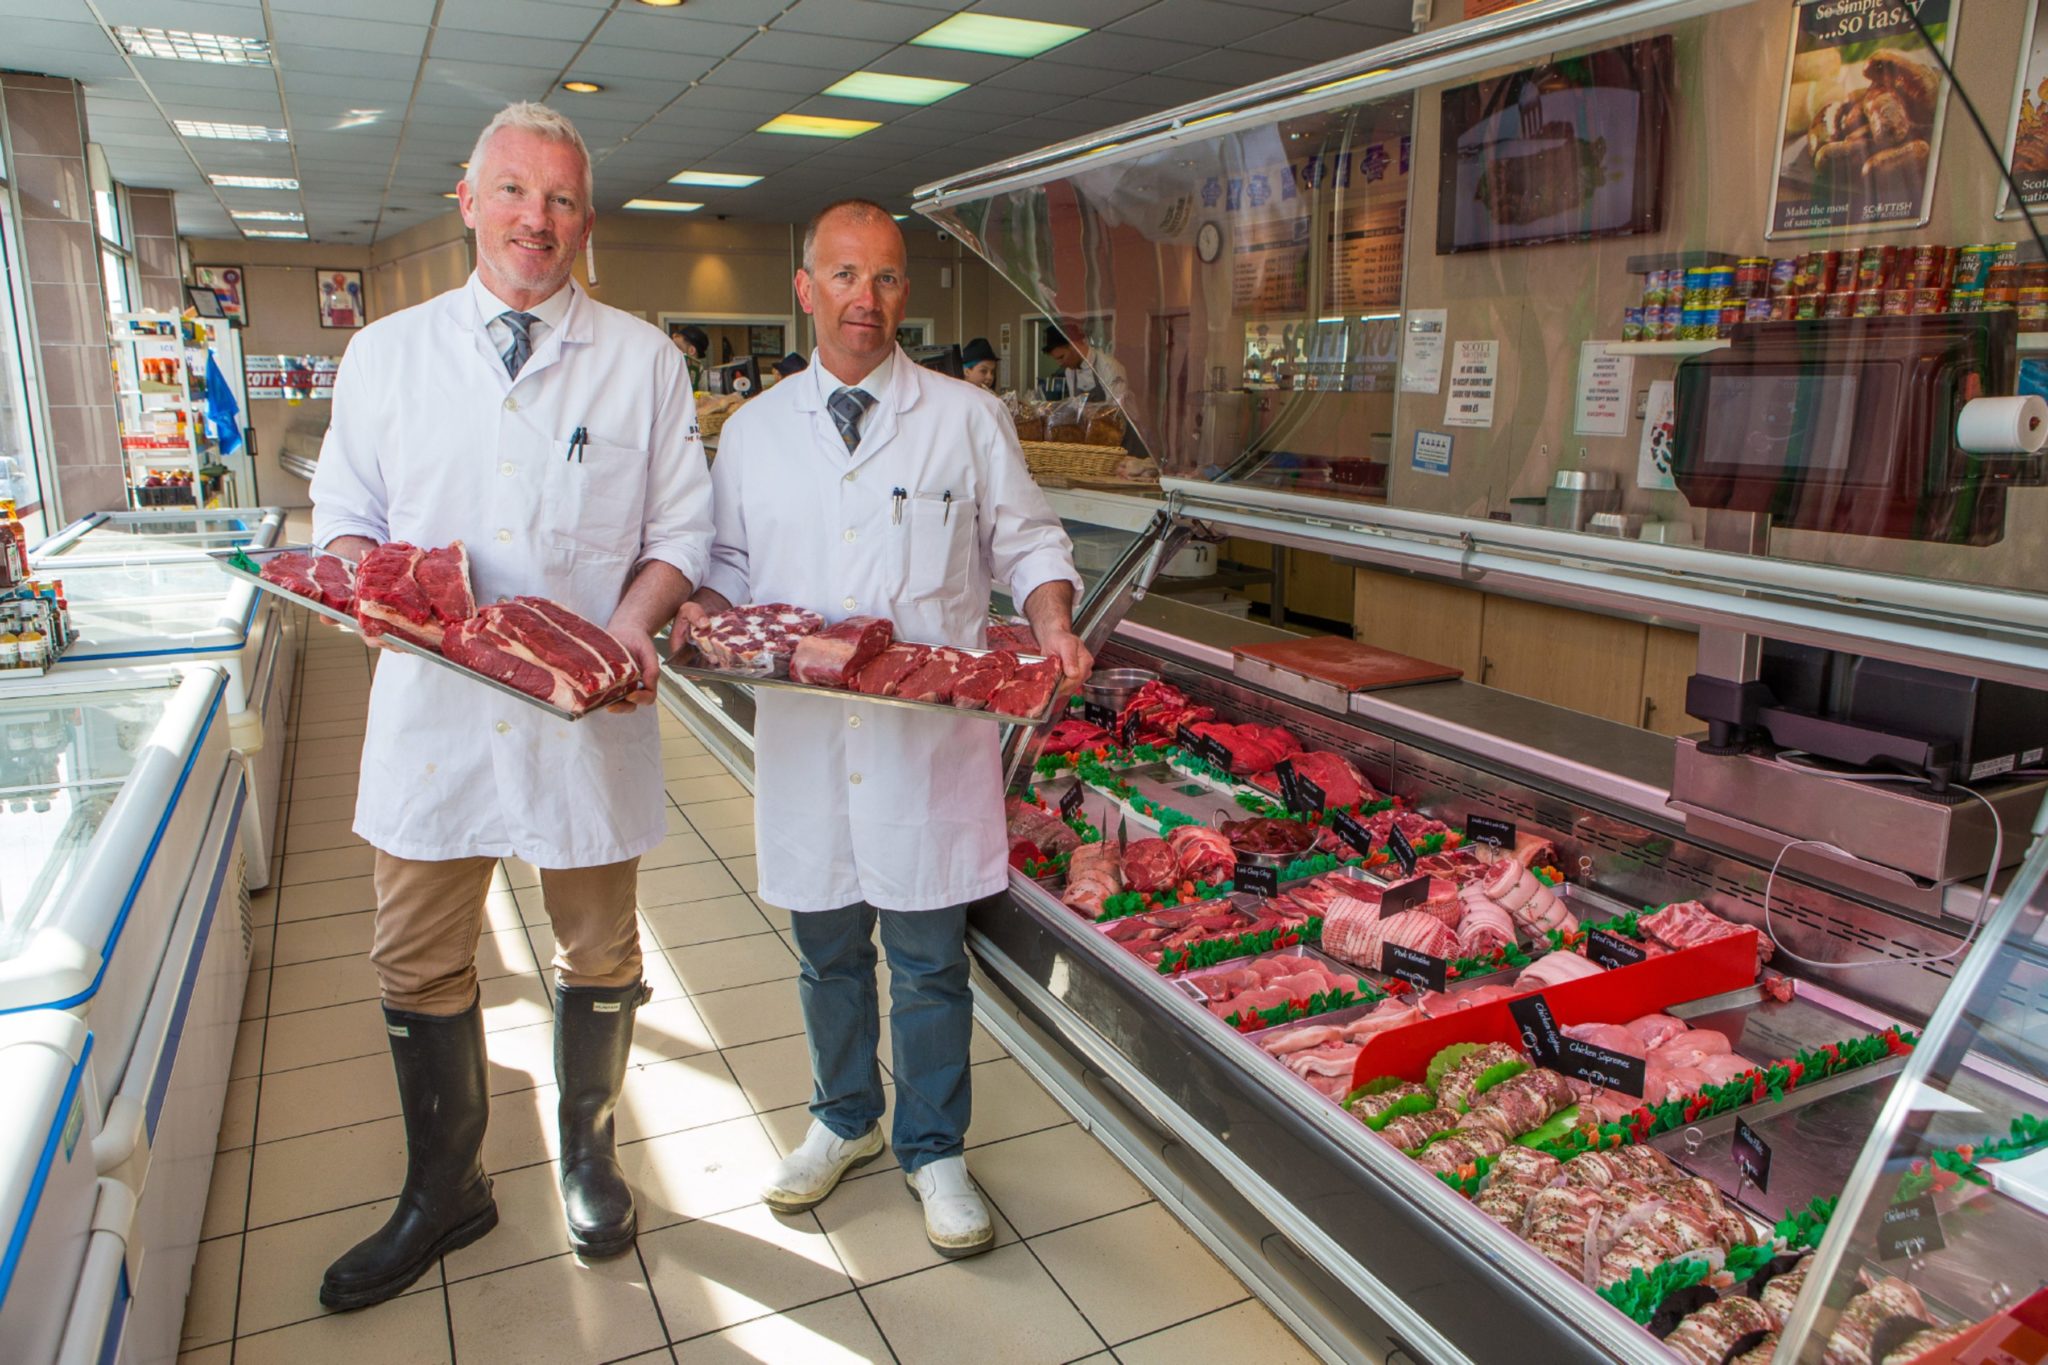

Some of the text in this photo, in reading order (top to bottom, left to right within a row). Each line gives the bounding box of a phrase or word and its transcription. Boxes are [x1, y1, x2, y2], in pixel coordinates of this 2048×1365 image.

[1815, 0, 1884, 20] So Simple
[1785, 203, 1850, 217] Make the most
[1783, 219, 1793, 228] of
[1569, 1042, 1597, 1058] Chicken
